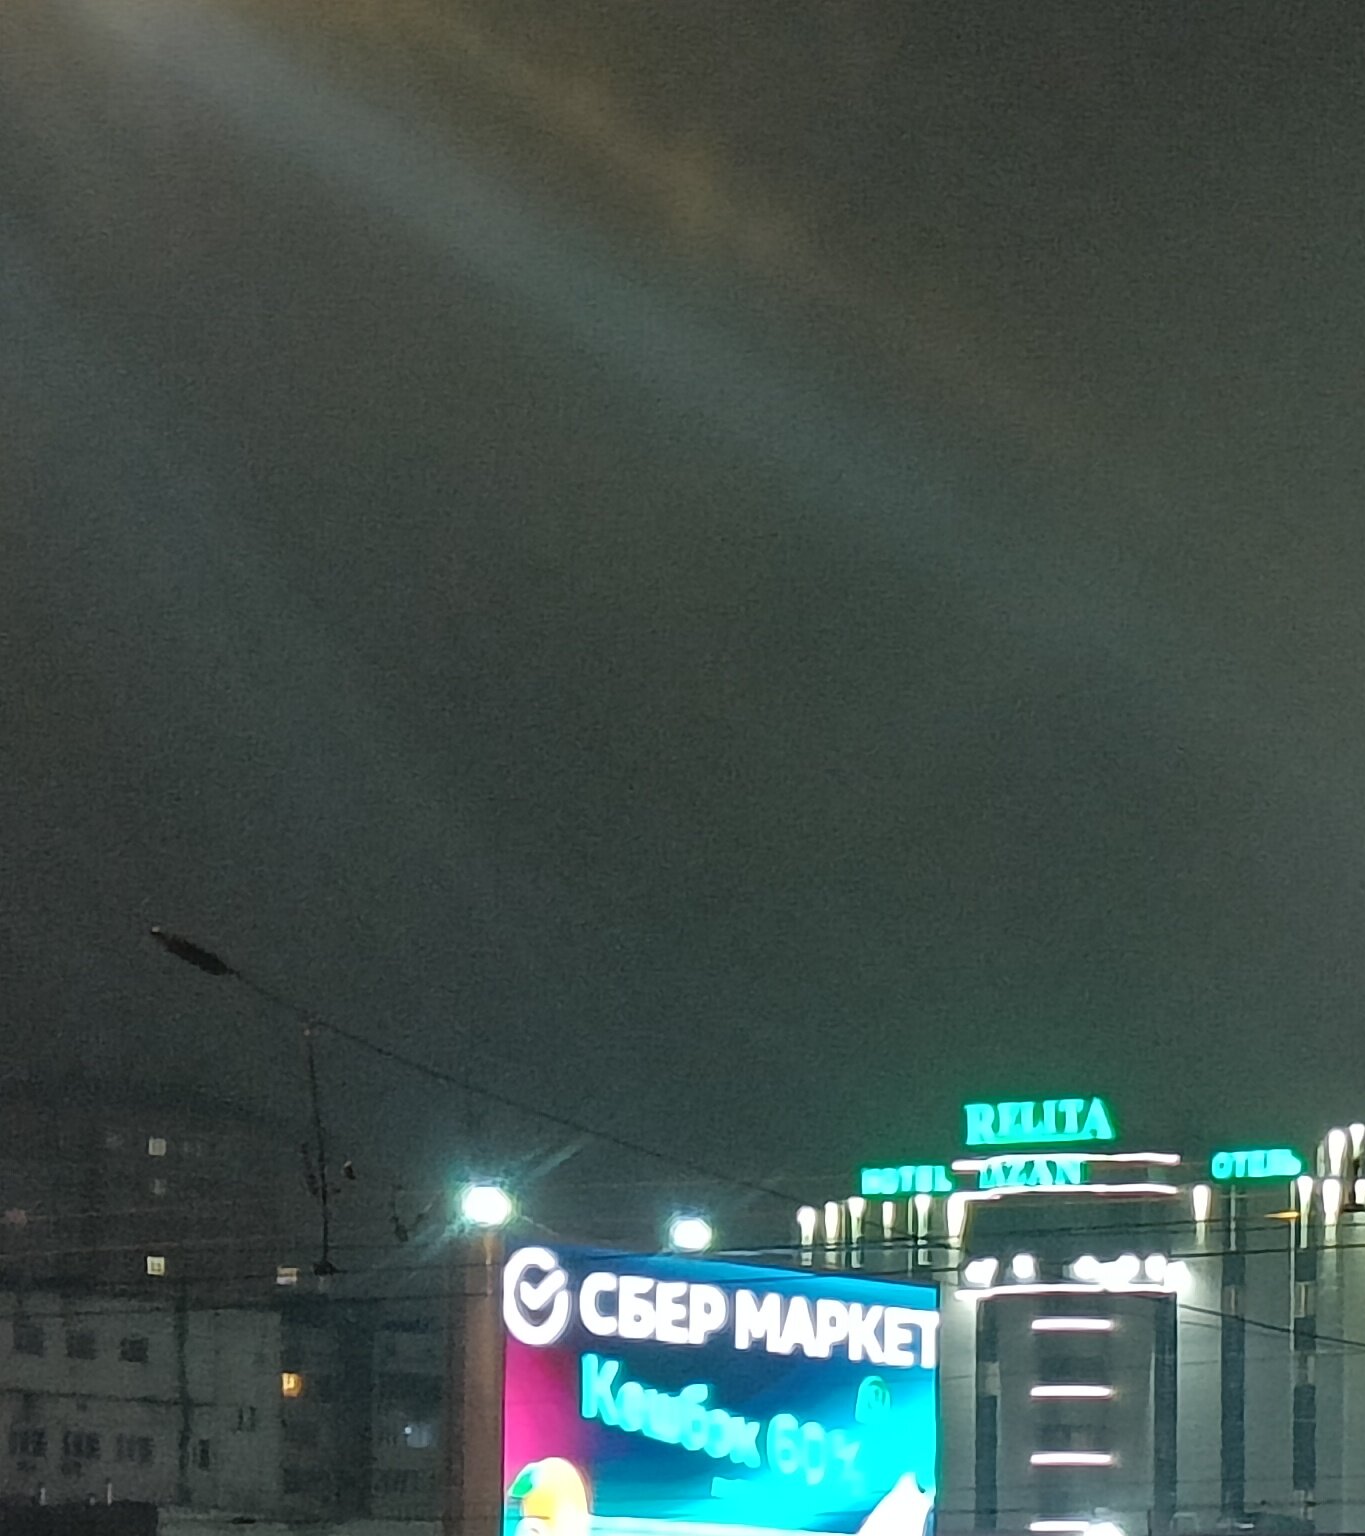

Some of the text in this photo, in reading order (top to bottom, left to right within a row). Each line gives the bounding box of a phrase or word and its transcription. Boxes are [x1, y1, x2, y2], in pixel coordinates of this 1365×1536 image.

[965, 1097, 1115, 1145] RELITA
[579, 1271, 940, 1369] СБЕР МАРКЕТ
